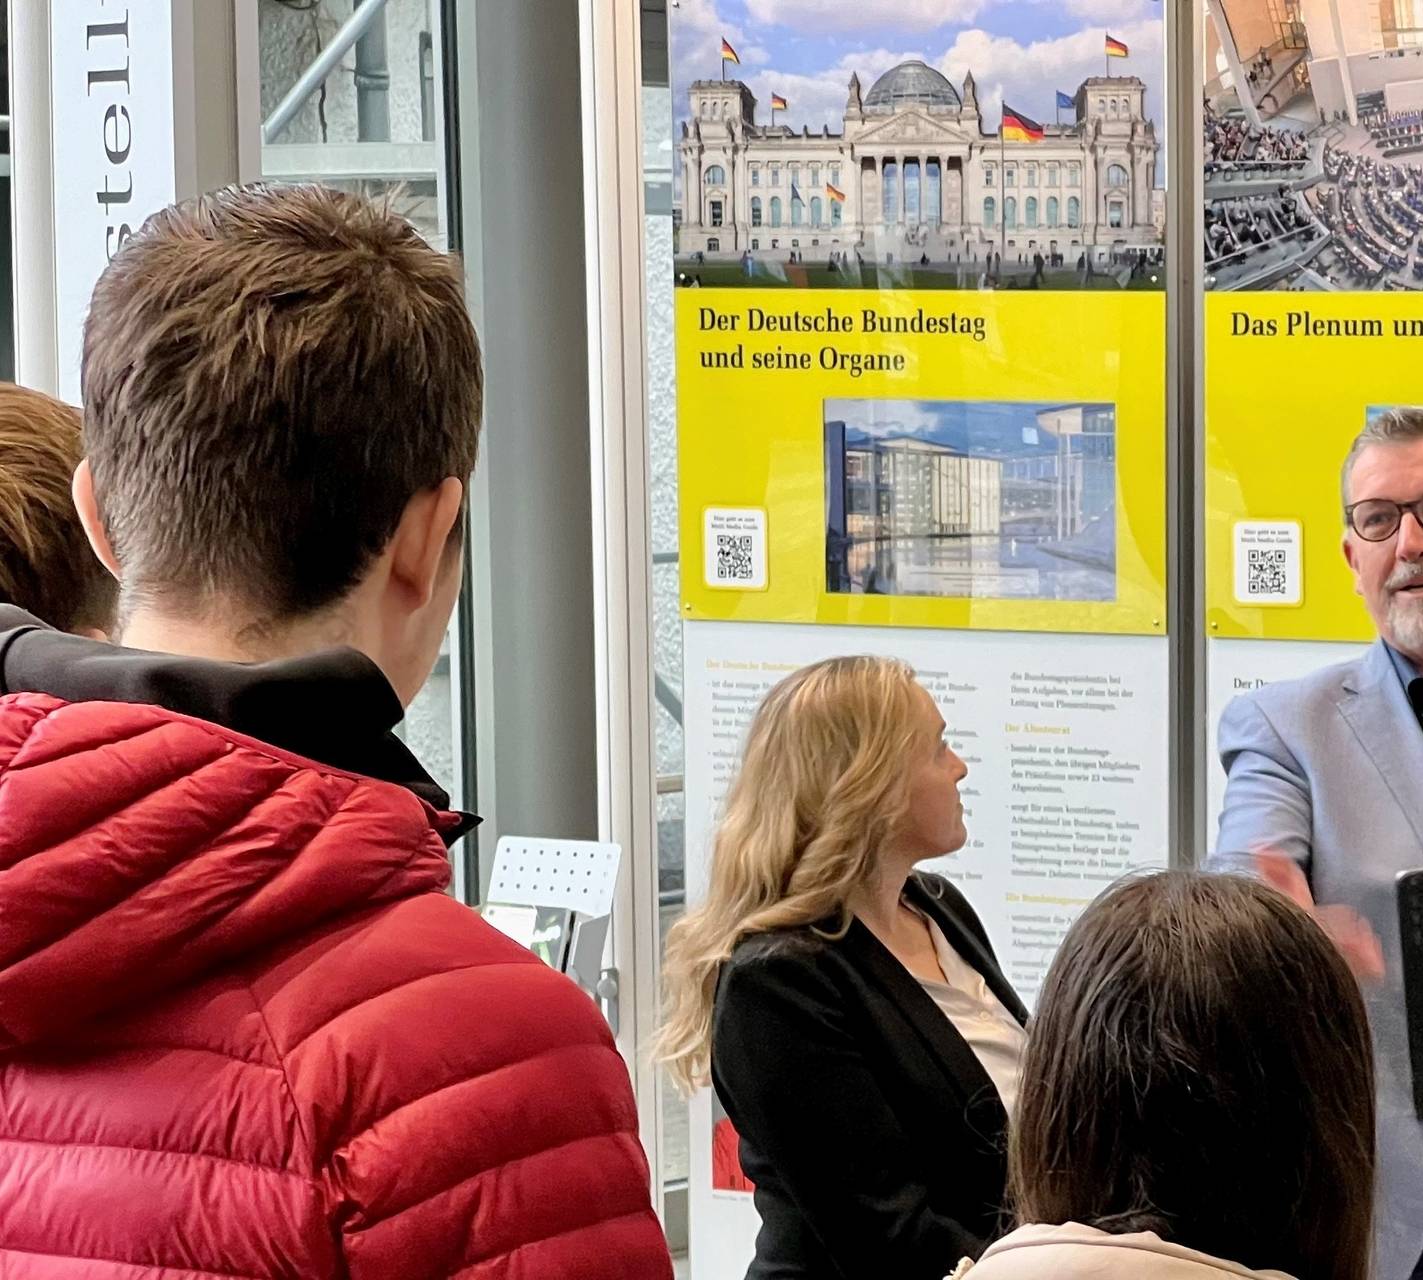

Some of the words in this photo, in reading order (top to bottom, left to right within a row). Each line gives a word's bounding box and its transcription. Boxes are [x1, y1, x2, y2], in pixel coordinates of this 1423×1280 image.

[86, 0, 132, 263] stell
[699, 308, 740, 331] Der
[749, 308, 853, 332] Deutsche
[861, 308, 986, 341] Bundestag
[1230, 311, 1278, 337] Das
[1286, 311, 1384, 337] Plenum
[700, 344, 745, 369] und
[752, 345, 811, 369] seine
[819, 346, 905, 378] Organe
[1233, 677, 1252, 689] Der
